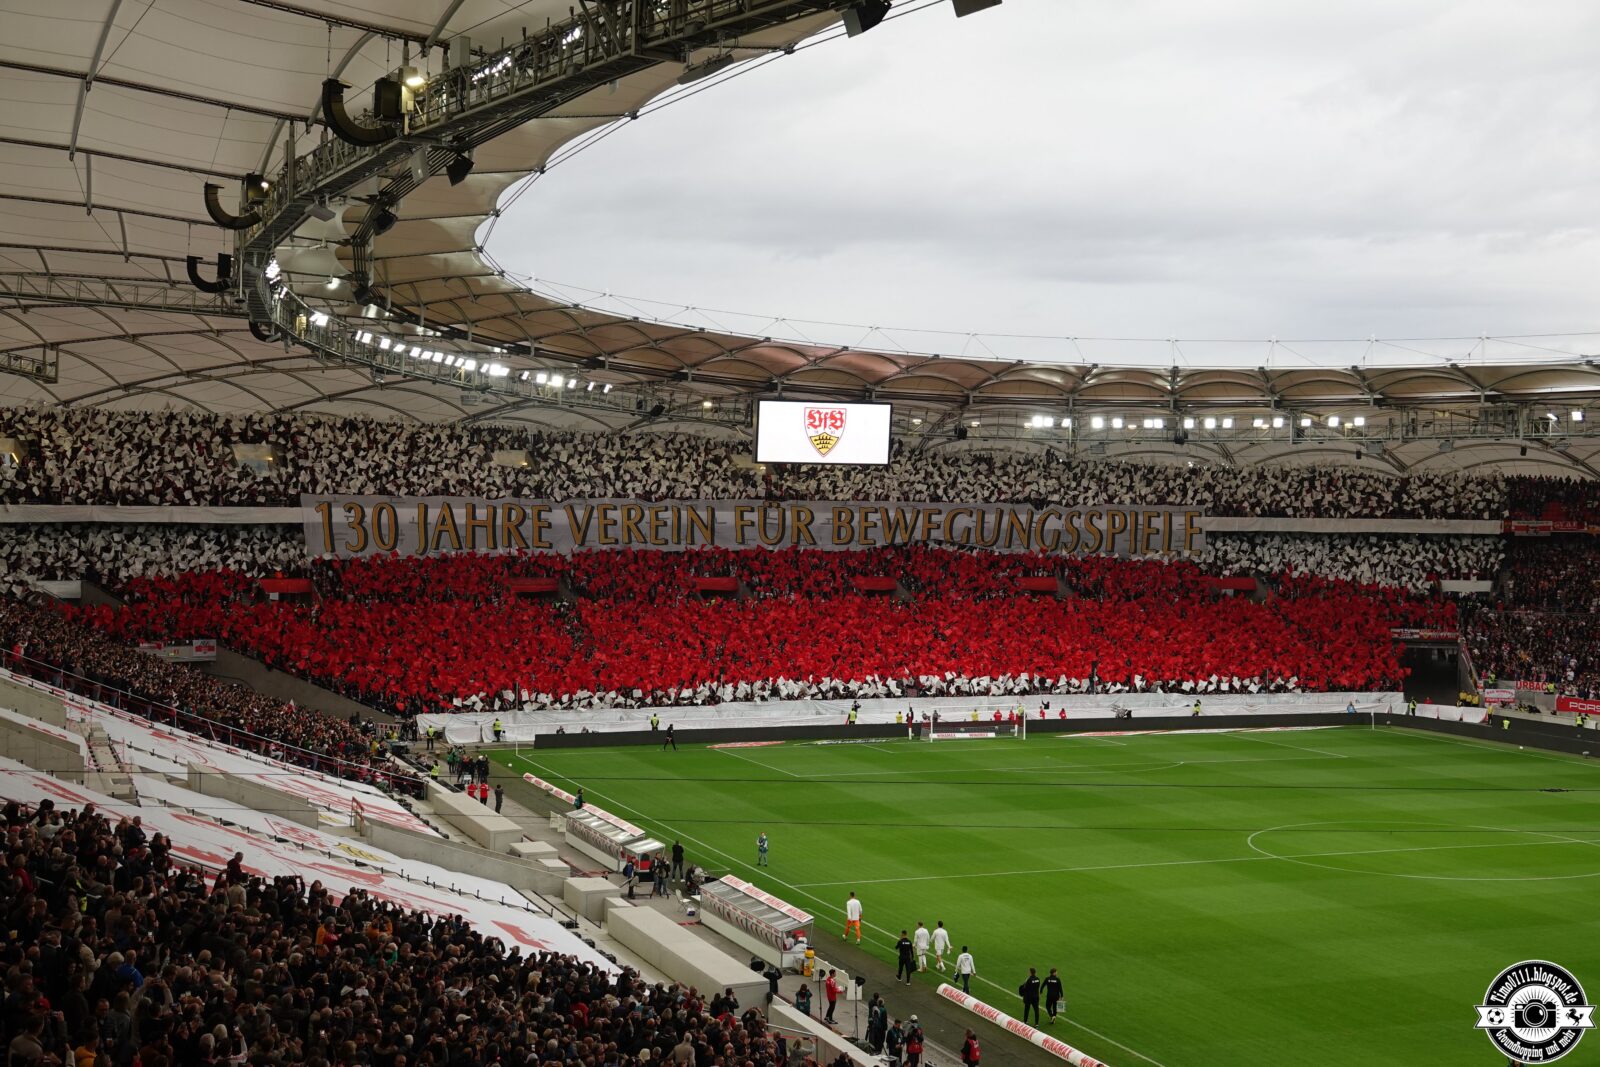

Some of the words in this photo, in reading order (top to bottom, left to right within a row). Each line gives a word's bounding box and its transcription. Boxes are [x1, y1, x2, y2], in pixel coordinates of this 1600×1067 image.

[807, 409, 844, 431] VfB
[315, 501, 399, 553] 130
[415, 501, 553, 555] JAHRE
[564, 503, 716, 547] VEREIN
[734, 501, 817, 546] FÜR
[832, 504, 1202, 557] BEWEGUNGSSPIELE
[1515, 679, 1548, 691] URBAC
